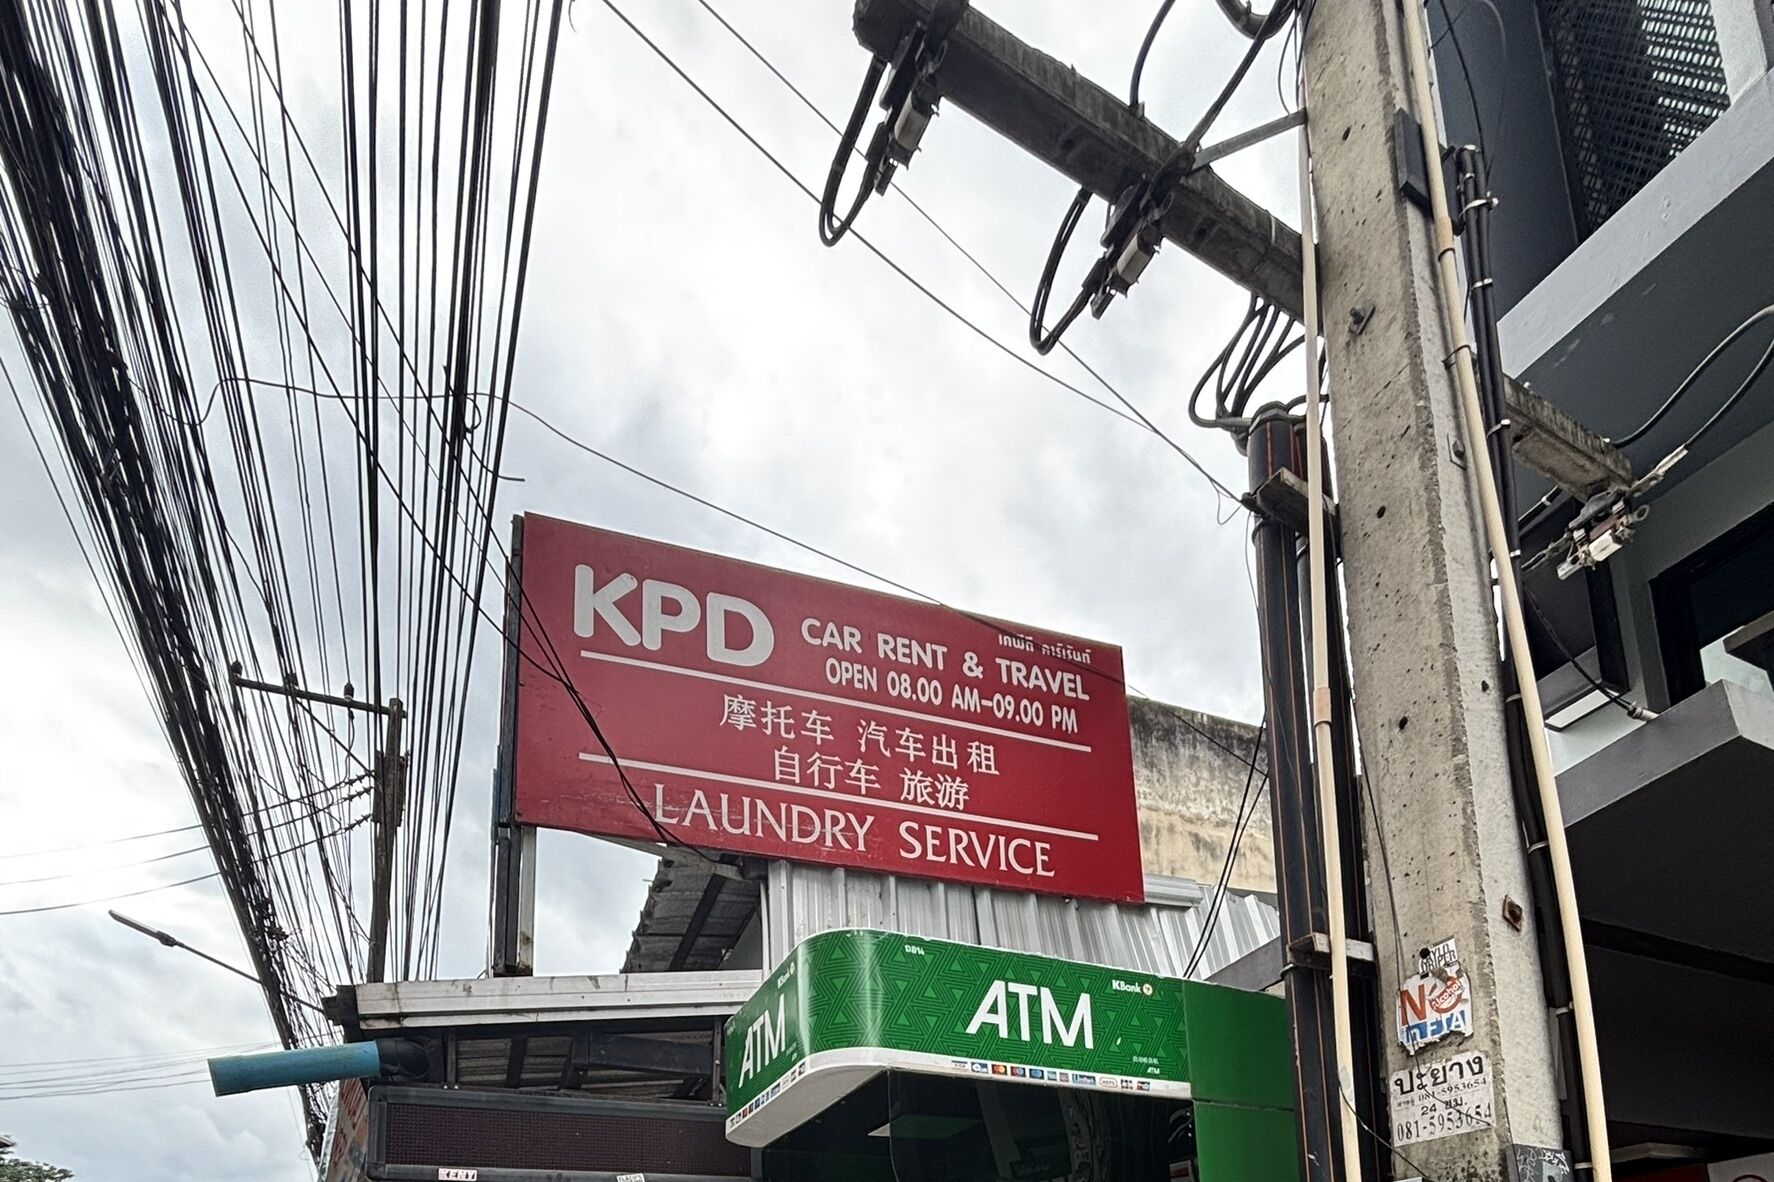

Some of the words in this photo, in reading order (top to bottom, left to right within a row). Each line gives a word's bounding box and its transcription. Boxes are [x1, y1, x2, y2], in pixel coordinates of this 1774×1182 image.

[574, 564, 774, 667] KPD
[801, 618, 862, 654] CAR
[877, 632, 948, 671] RENT
[962, 651, 983, 679] &
[995, 657, 1089, 701] TRAVEL
[825, 659, 878, 694] OPEN
[886, 671, 943, 707] 08.00
[1051, 704, 1078, 734] PM
[719, 693, 834, 745] 摩托车
[856, 716, 1000, 777] 汽车出租
[773, 745, 881, 797] 自行车
[898, 767, 969, 813] 旅游
[654, 782, 875, 853] LAUNDRY
[899, 821, 1056, 879] SERVICE
[965, 980, 1094, 1049] ATM
[1112, 979, 1142, 993] KBank
[738, 992, 786, 1088] ATM
[1394, 1056, 1484, 1095] ปะยาง
[1421, 1103, 1437, 1116] 24
[1397, 1102, 1492, 1142] 081-5953654
